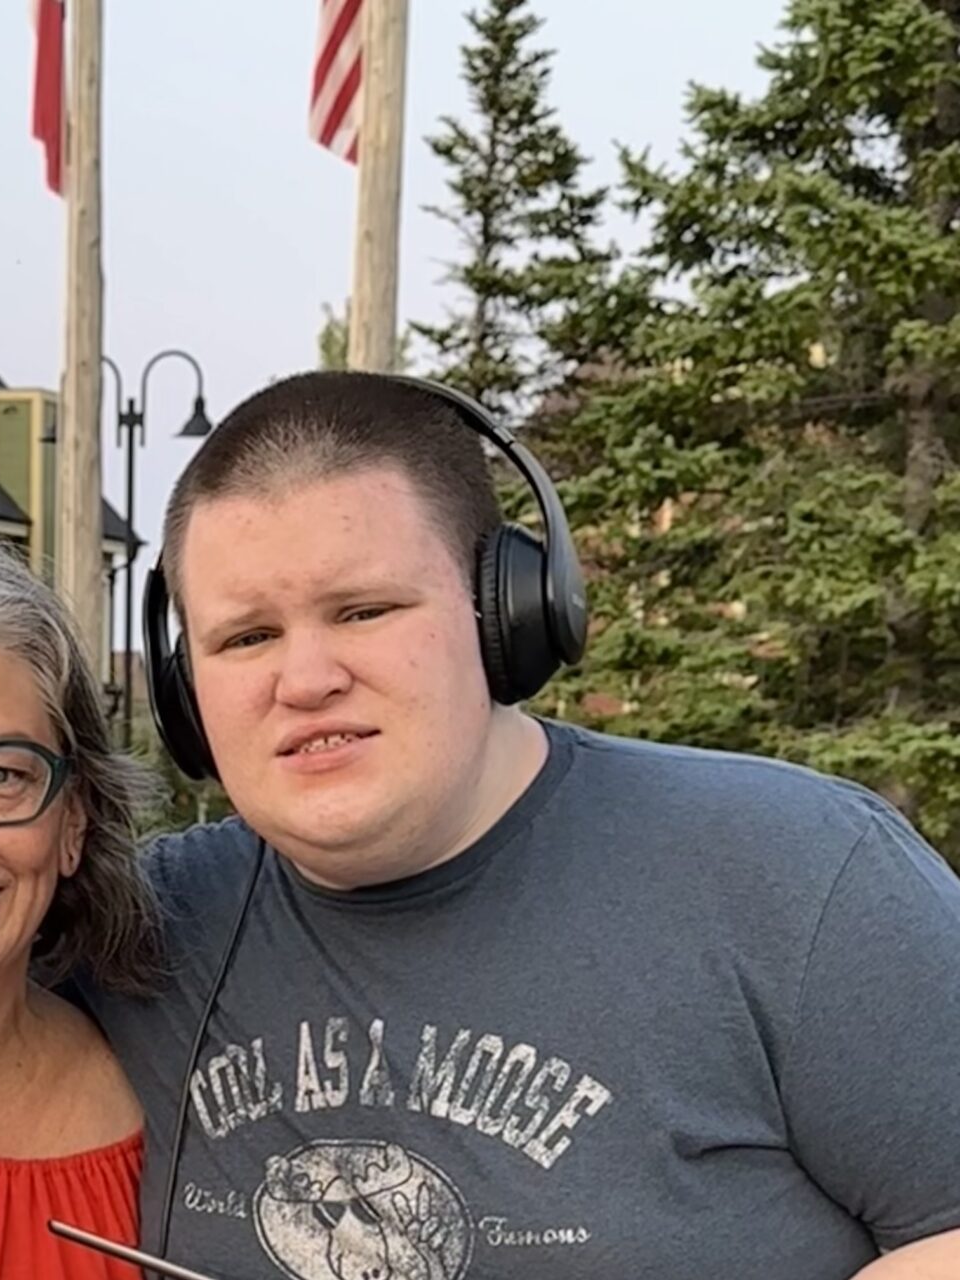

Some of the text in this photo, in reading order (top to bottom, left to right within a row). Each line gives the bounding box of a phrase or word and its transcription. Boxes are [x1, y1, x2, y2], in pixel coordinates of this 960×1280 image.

[295, 1016, 349, 1113] AS
[359, 1018, 395, 1107] A
[406, 1024, 614, 1170] MOOSE
[479, 1216, 592, 1247] Famous
